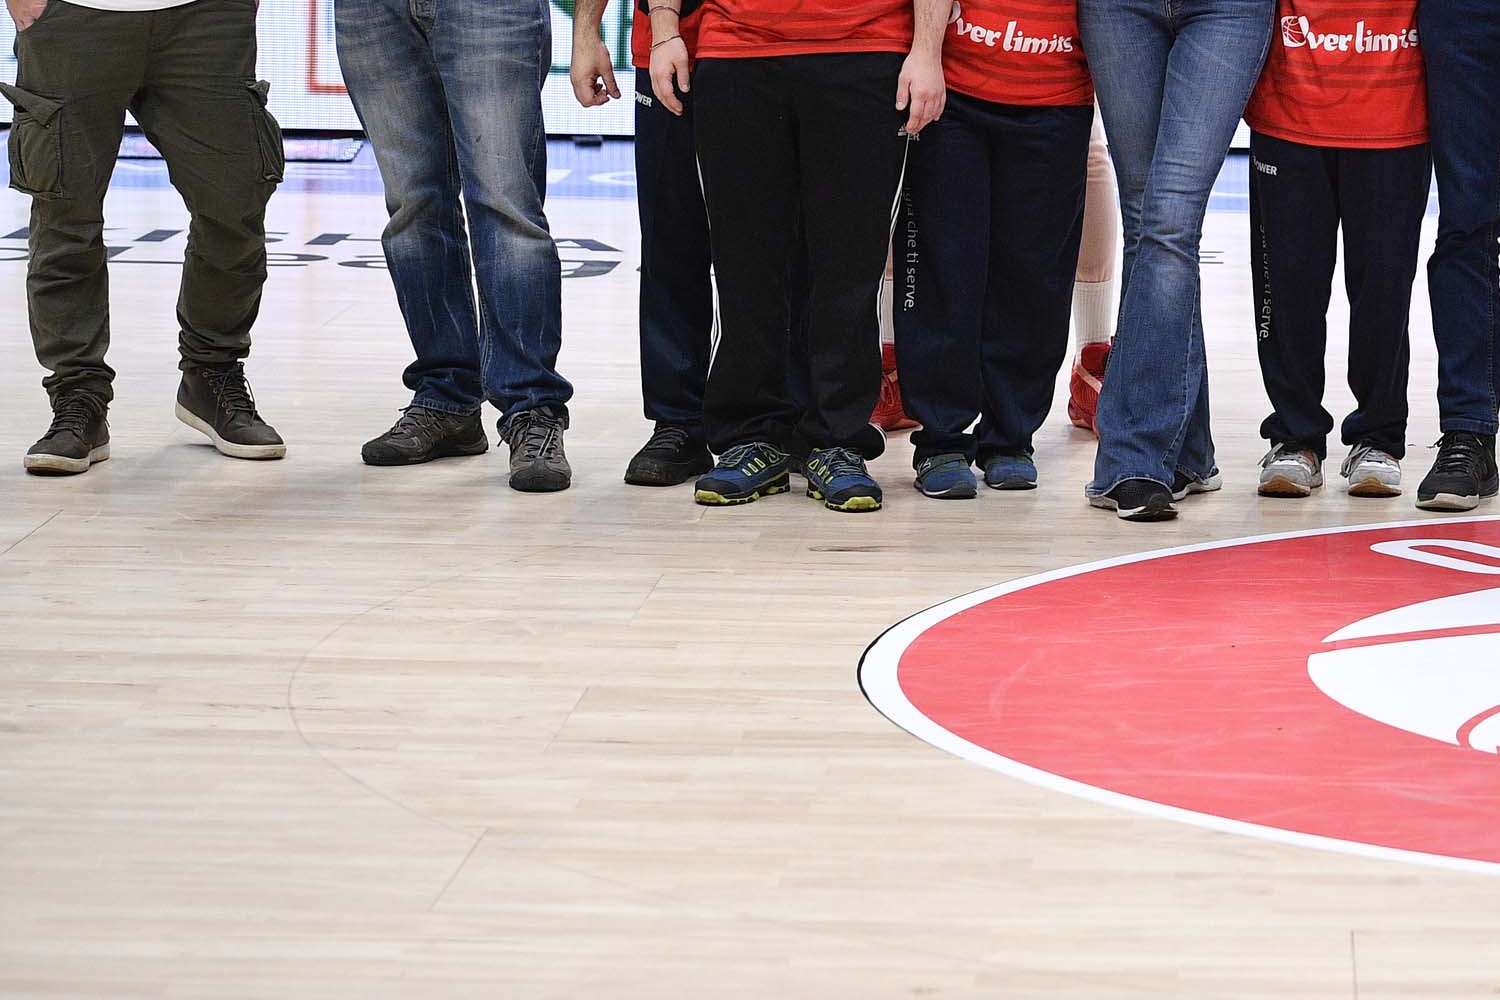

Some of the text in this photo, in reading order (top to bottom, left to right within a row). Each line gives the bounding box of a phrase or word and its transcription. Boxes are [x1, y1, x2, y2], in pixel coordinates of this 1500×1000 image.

[1002, 20, 1073, 55] limits
[1280, 15, 1353, 51] Over
[906, 251, 920, 264] ti
[903, 266, 917, 312] serve.
[1258, 298, 1272, 343] serve.
